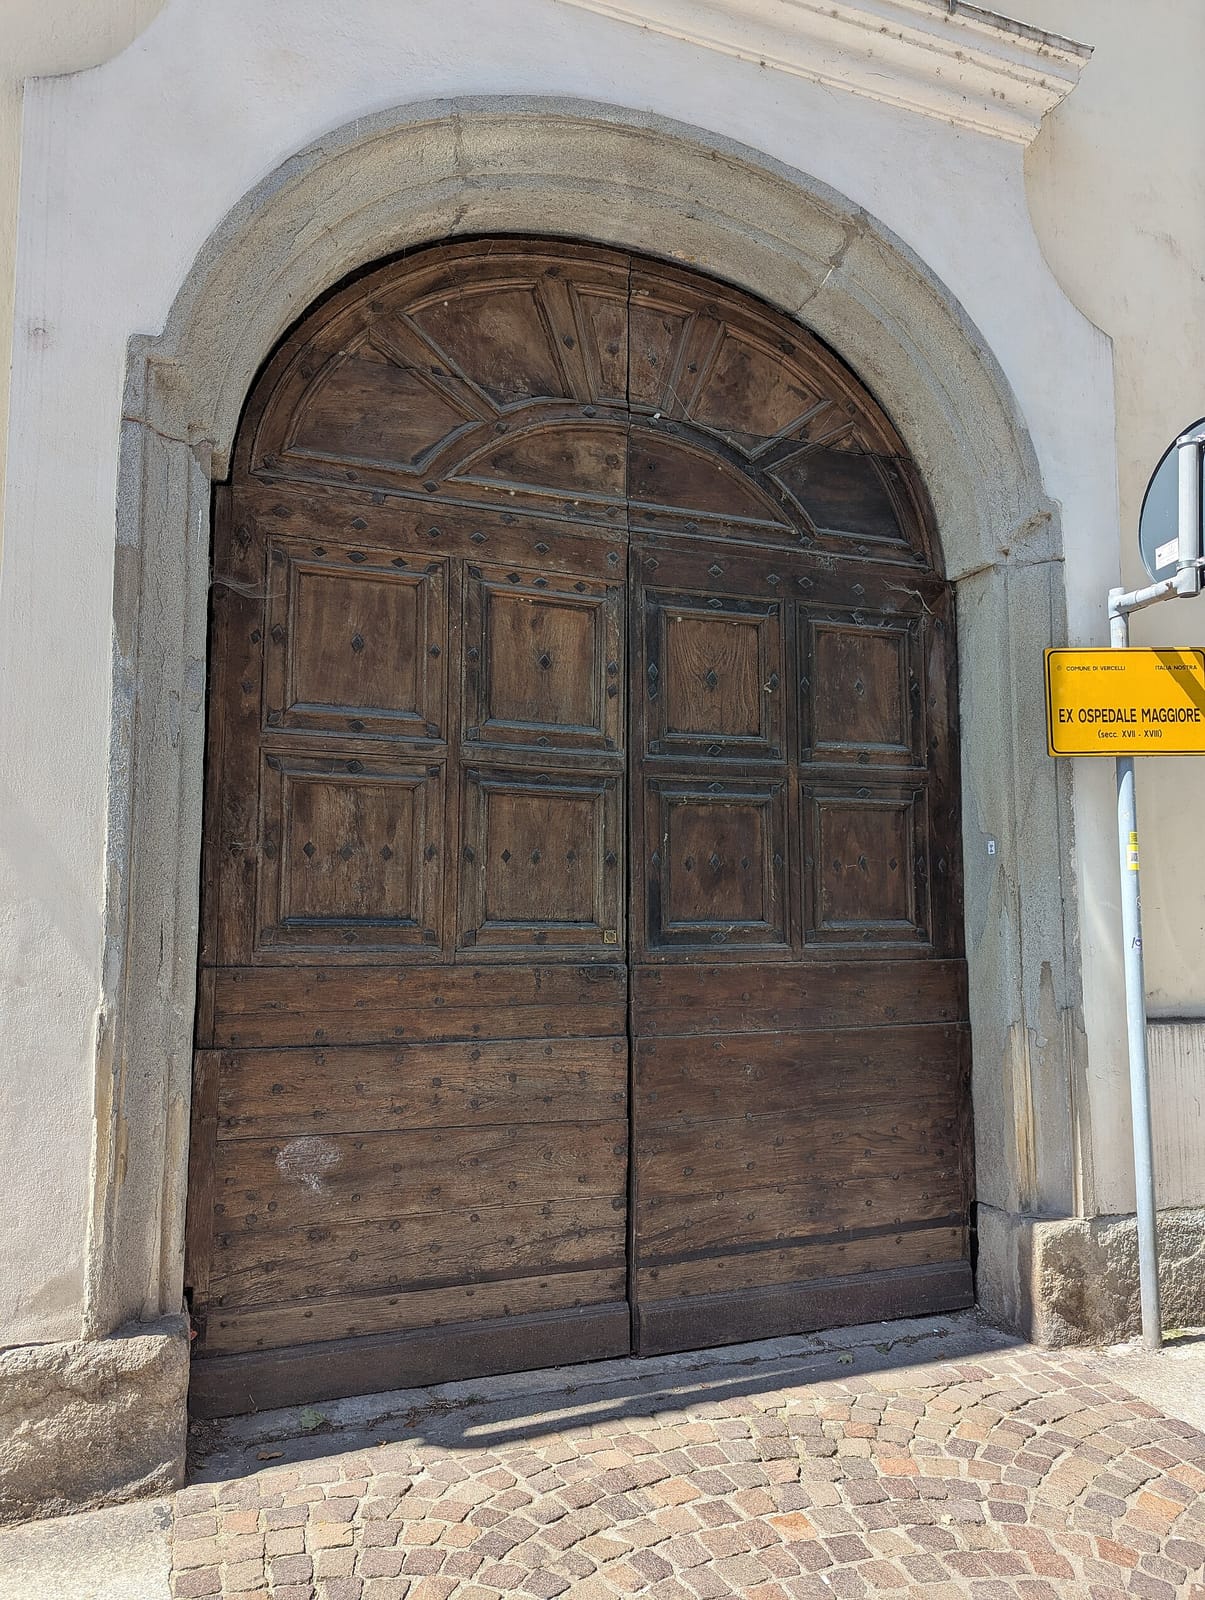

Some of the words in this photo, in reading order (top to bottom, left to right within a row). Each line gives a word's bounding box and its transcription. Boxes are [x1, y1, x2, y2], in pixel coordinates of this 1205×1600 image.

[1059, 708, 1074, 723] EX
[1078, 708, 1137, 723] OSPEDALE
[1141, 708, 1201, 723] MAGGIORE
[1097, 729, 1118, 738] (secc.
[1121, 729, 1136, 738] XVII
[1144, 729, 1163, 738] XVIII)
